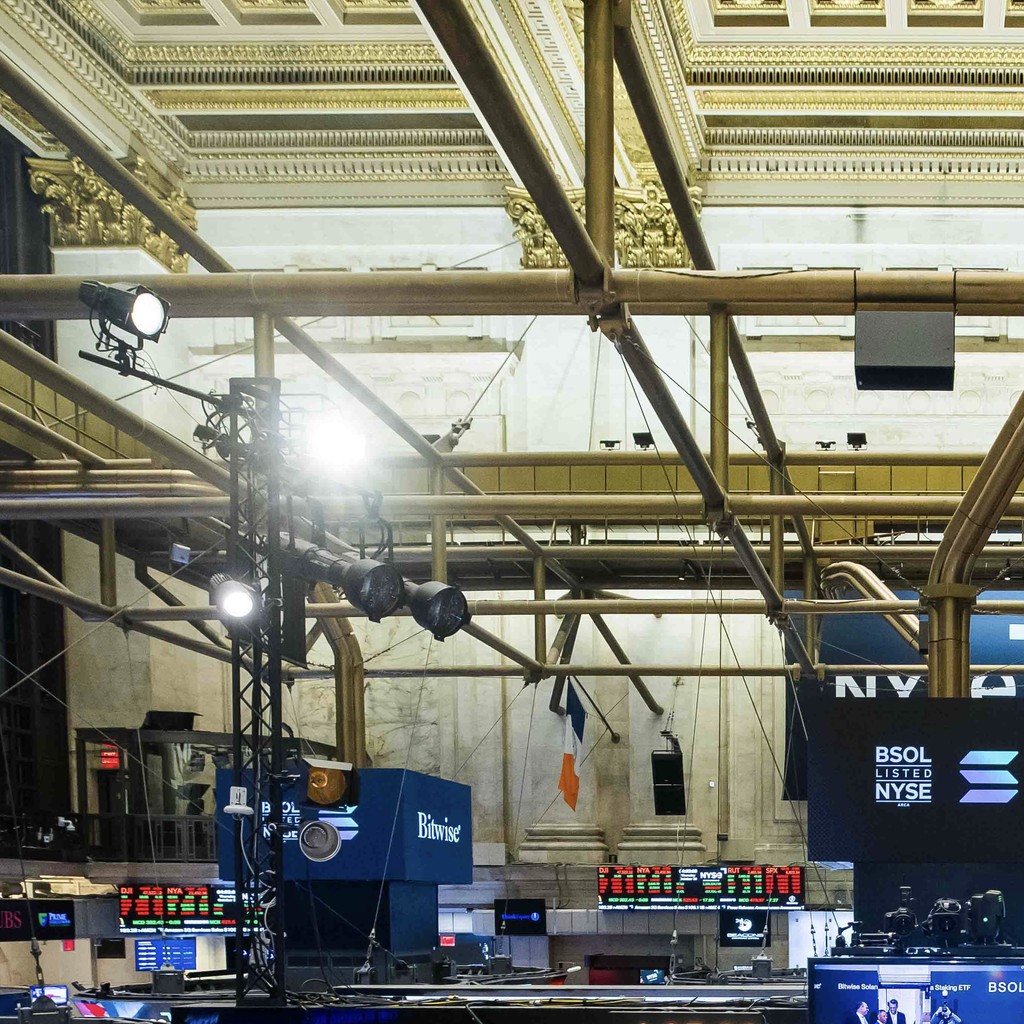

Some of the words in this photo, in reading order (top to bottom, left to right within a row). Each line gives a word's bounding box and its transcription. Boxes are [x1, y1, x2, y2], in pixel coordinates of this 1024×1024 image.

[875, 746, 932, 763] BSOL
[875, 768, 932, 778] LISTED
[875, 783, 932, 800] NYSE
[262, 801, 300, 813] BOL
[417, 811, 461, 843] Bitwise
